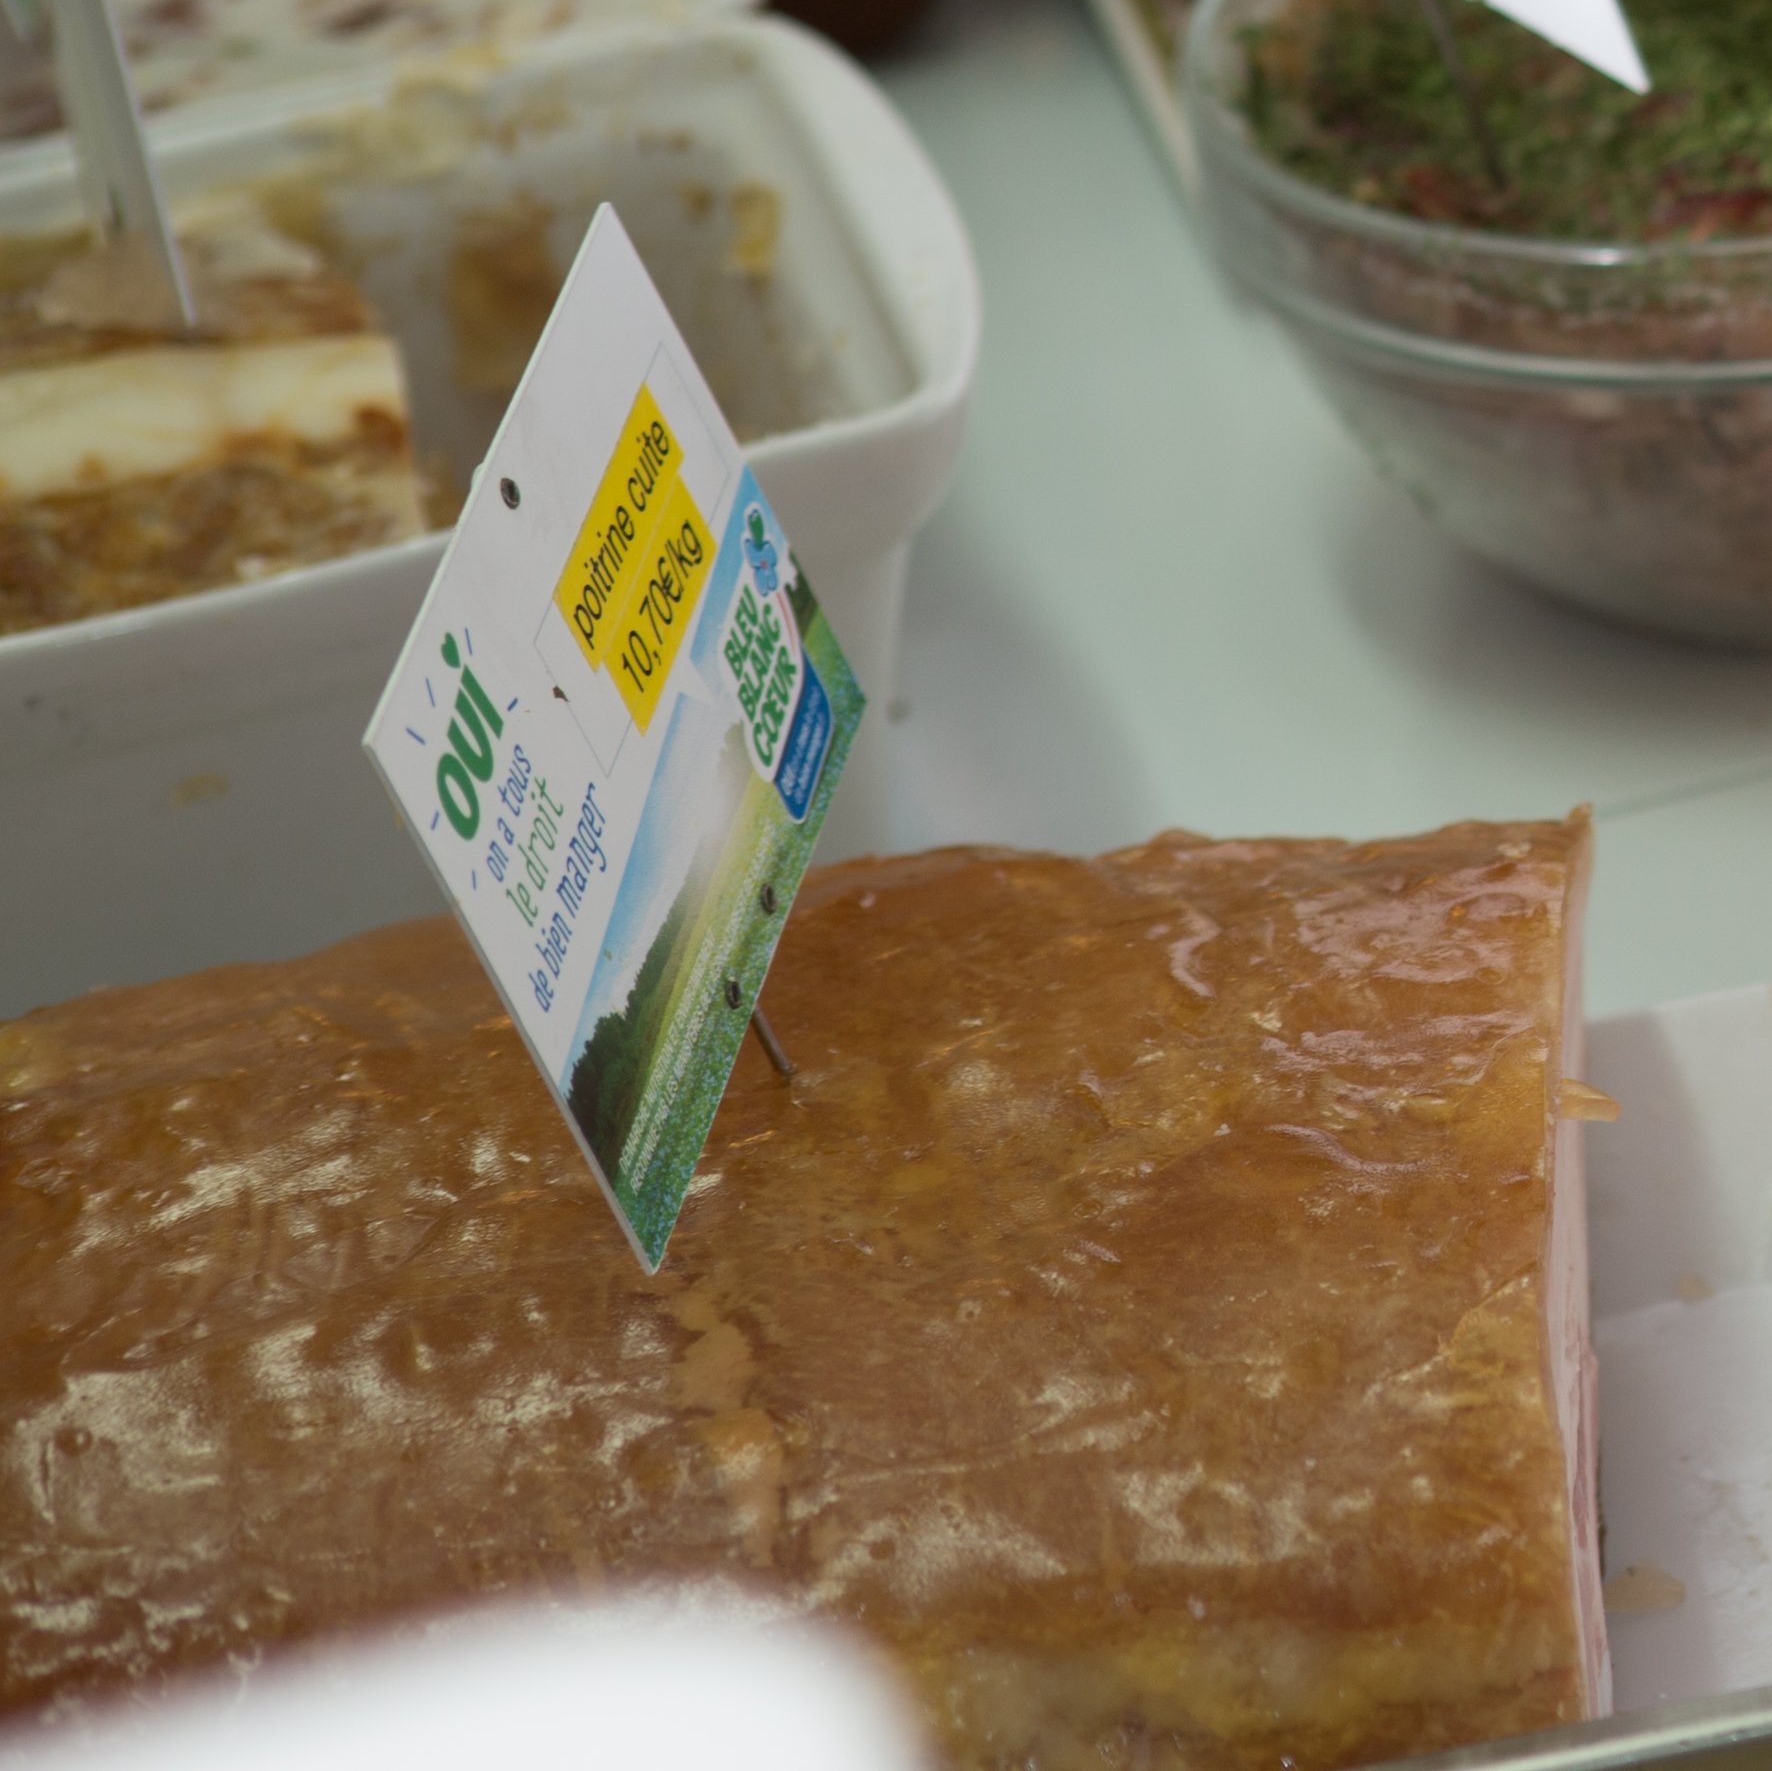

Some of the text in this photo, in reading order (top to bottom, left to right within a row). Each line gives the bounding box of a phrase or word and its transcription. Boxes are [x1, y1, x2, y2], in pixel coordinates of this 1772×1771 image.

[573, 420, 669, 650] poitrine cuite
[621, 519, 703, 692] 10,70€/kg
[724, 585, 758, 680] BLEU
[737, 603, 779, 721] BLANC
[486, 743, 531, 882] on a tous
[505, 776, 564, 927] le droit
[528, 781, 606, 1012] de bien manger
